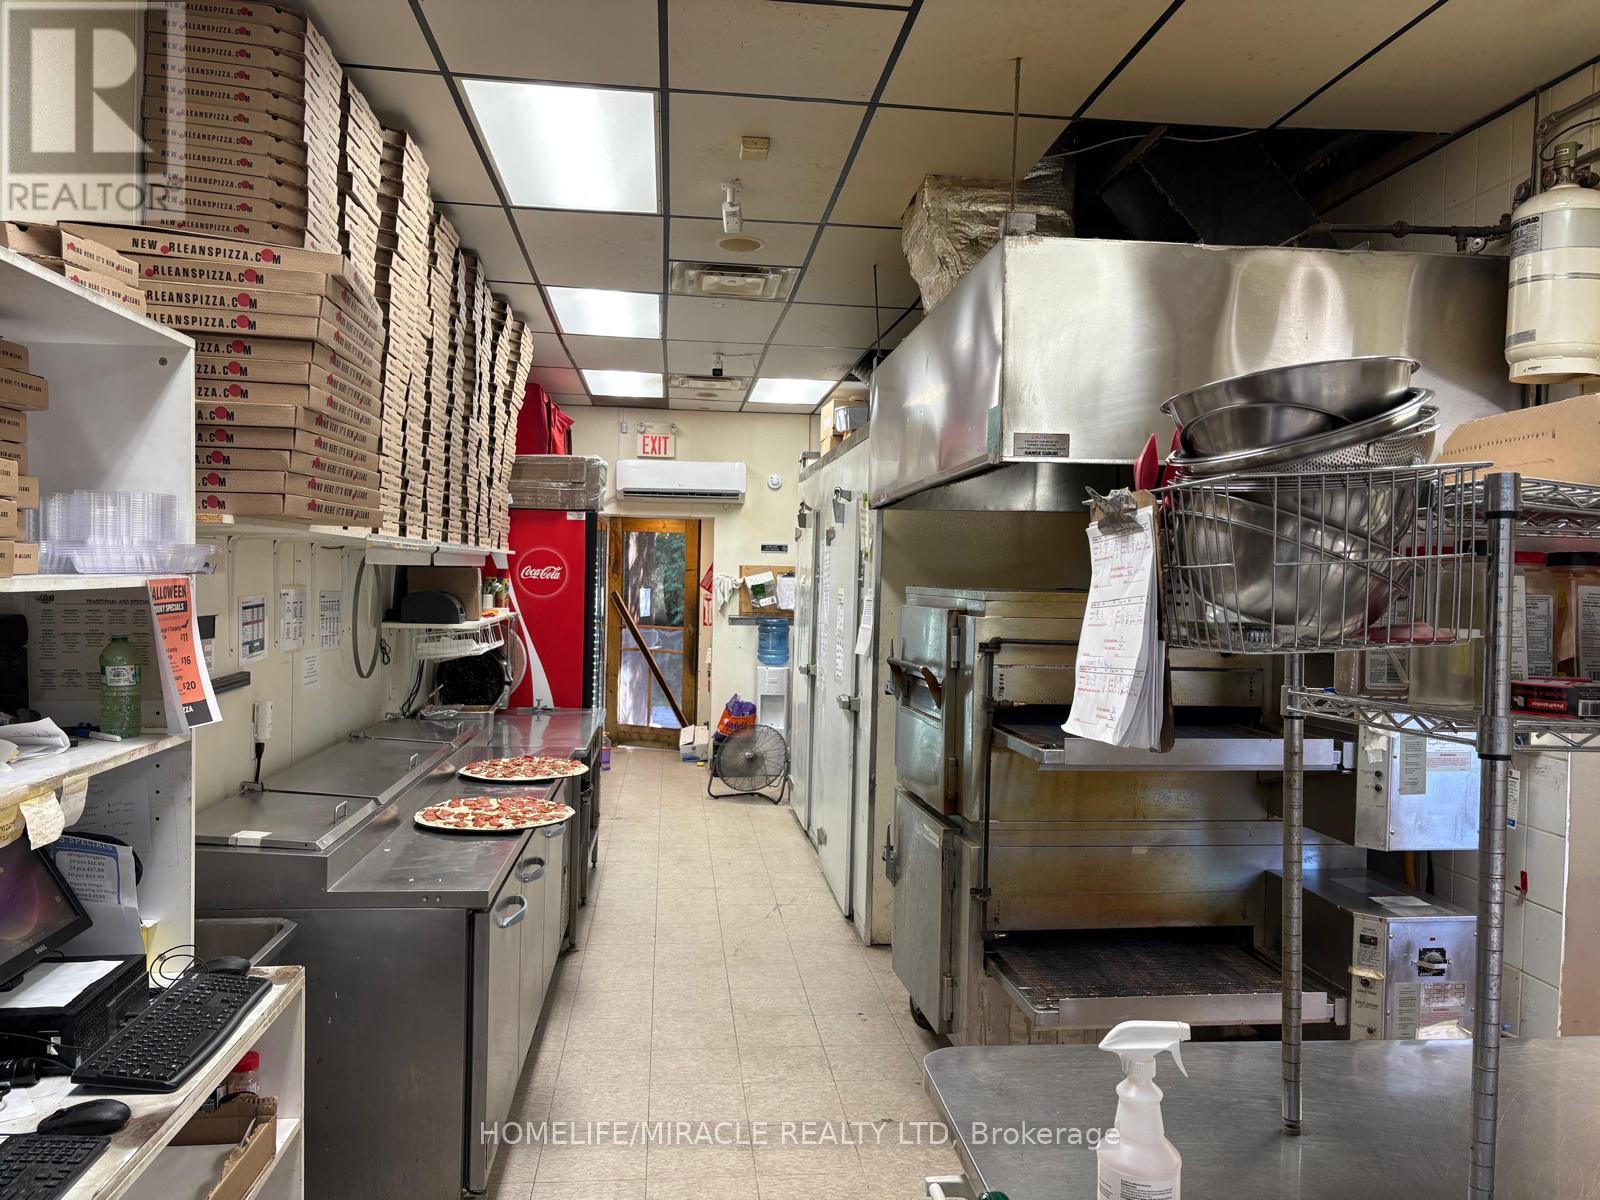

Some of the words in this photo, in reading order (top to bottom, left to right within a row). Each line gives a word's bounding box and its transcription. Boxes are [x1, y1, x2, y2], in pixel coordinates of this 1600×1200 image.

[164, 2, 180, 10] NEW
[161, 63, 177, 71] NEW
[161, 85, 176, 93] NEW
[159, 106, 175, 114] NEW
[161, 128, 177, 137] NEW
[161, 150, 177, 158] NEW
[162, 172, 178, 180] NEW
[162, 194, 178, 203] NEW
[160, 218, 176, 226] NEW
[132, 237, 158, 250] NEW
[146, 290, 258, 309] RLEANSPIZZA.COM
[642, 435, 670, 455] EXIT
[165, 602, 185, 612] SPECIALS
[181, 655, 191, 666] $16
[182, 680, 197, 691] $20
